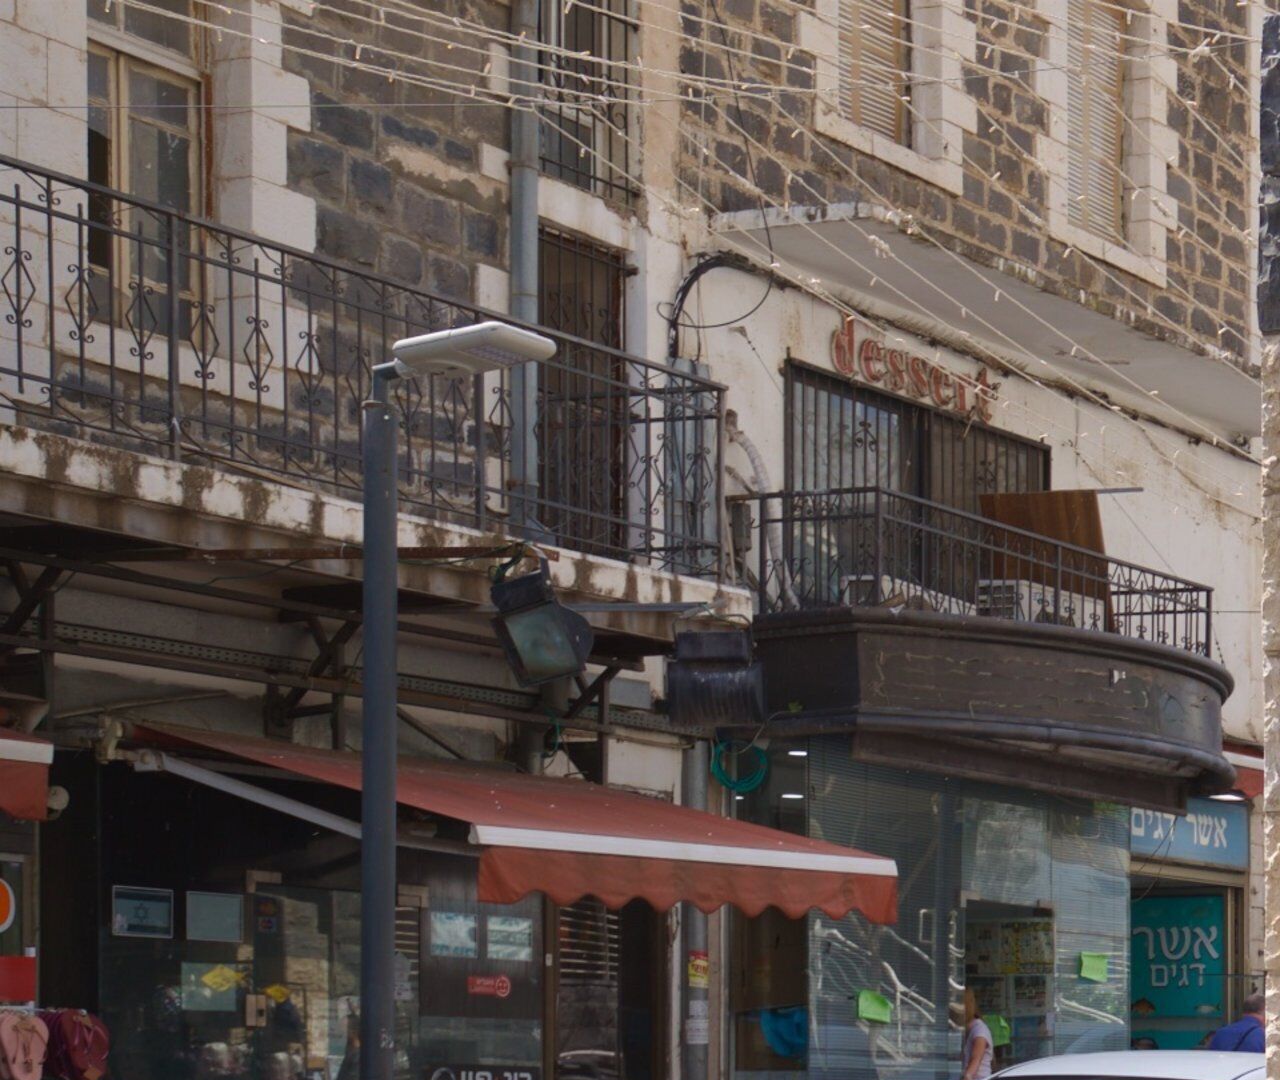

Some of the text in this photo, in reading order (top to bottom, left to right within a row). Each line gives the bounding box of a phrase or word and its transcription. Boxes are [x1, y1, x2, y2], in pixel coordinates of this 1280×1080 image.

[832, 312, 998, 425] dessert
[1131, 807, 1228, 848] אשר דגים
[1132, 925, 1220, 961] אשר
[1151, 964, 1206, 988] דגים
